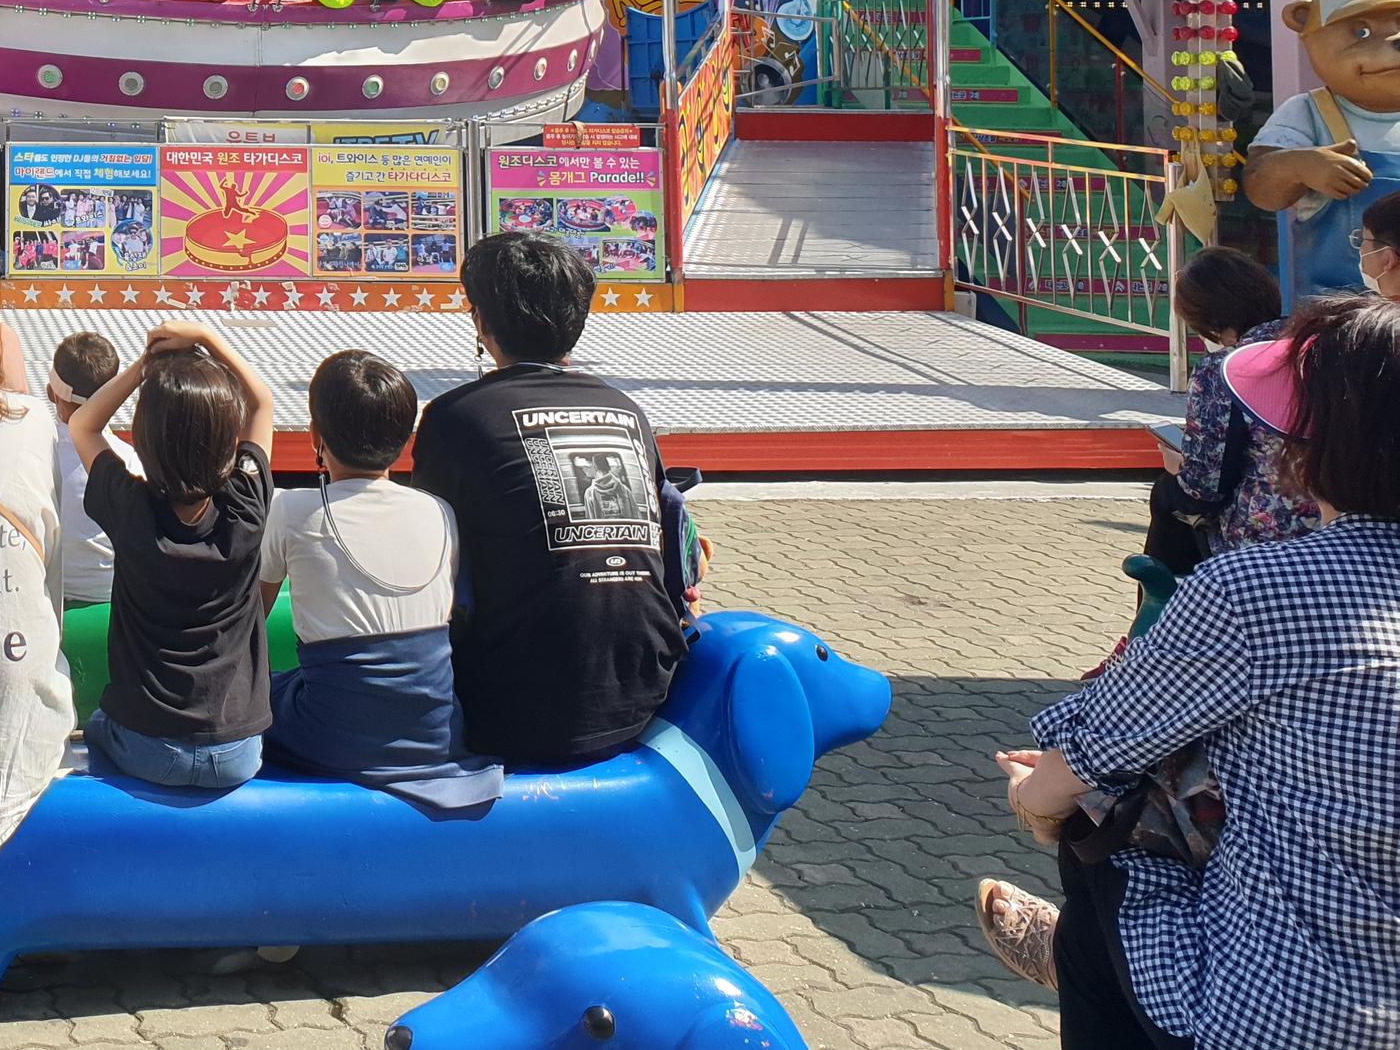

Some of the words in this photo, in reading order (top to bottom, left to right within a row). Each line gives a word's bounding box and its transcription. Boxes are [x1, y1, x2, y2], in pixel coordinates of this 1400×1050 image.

[166, 151, 213, 166] 대한민국
[217, 152, 240, 166] 원조
[243, 152, 302, 166] 타가디스코
[337, 153, 378, 164] 트와이스
[380, 154, 389, 166] 등
[392, 154, 411, 167] 많은
[414, 153, 452, 167] 연예인이
[593, 156, 604, 169] 볼
[607, 157, 616, 168] 수
[619, 156, 640, 169] 있는
[346, 171, 374, 183] 즐기고
[376, 171, 385, 183] 간
[388, 171, 452, 183] 타가다디스코
[549, 171, 587, 186] 몸개그
[589, 171, 645, 184] Parade!!
[523, 411, 635, 429] UNCERTAIN
[554, 524, 648, 543] UNCERTAIN
